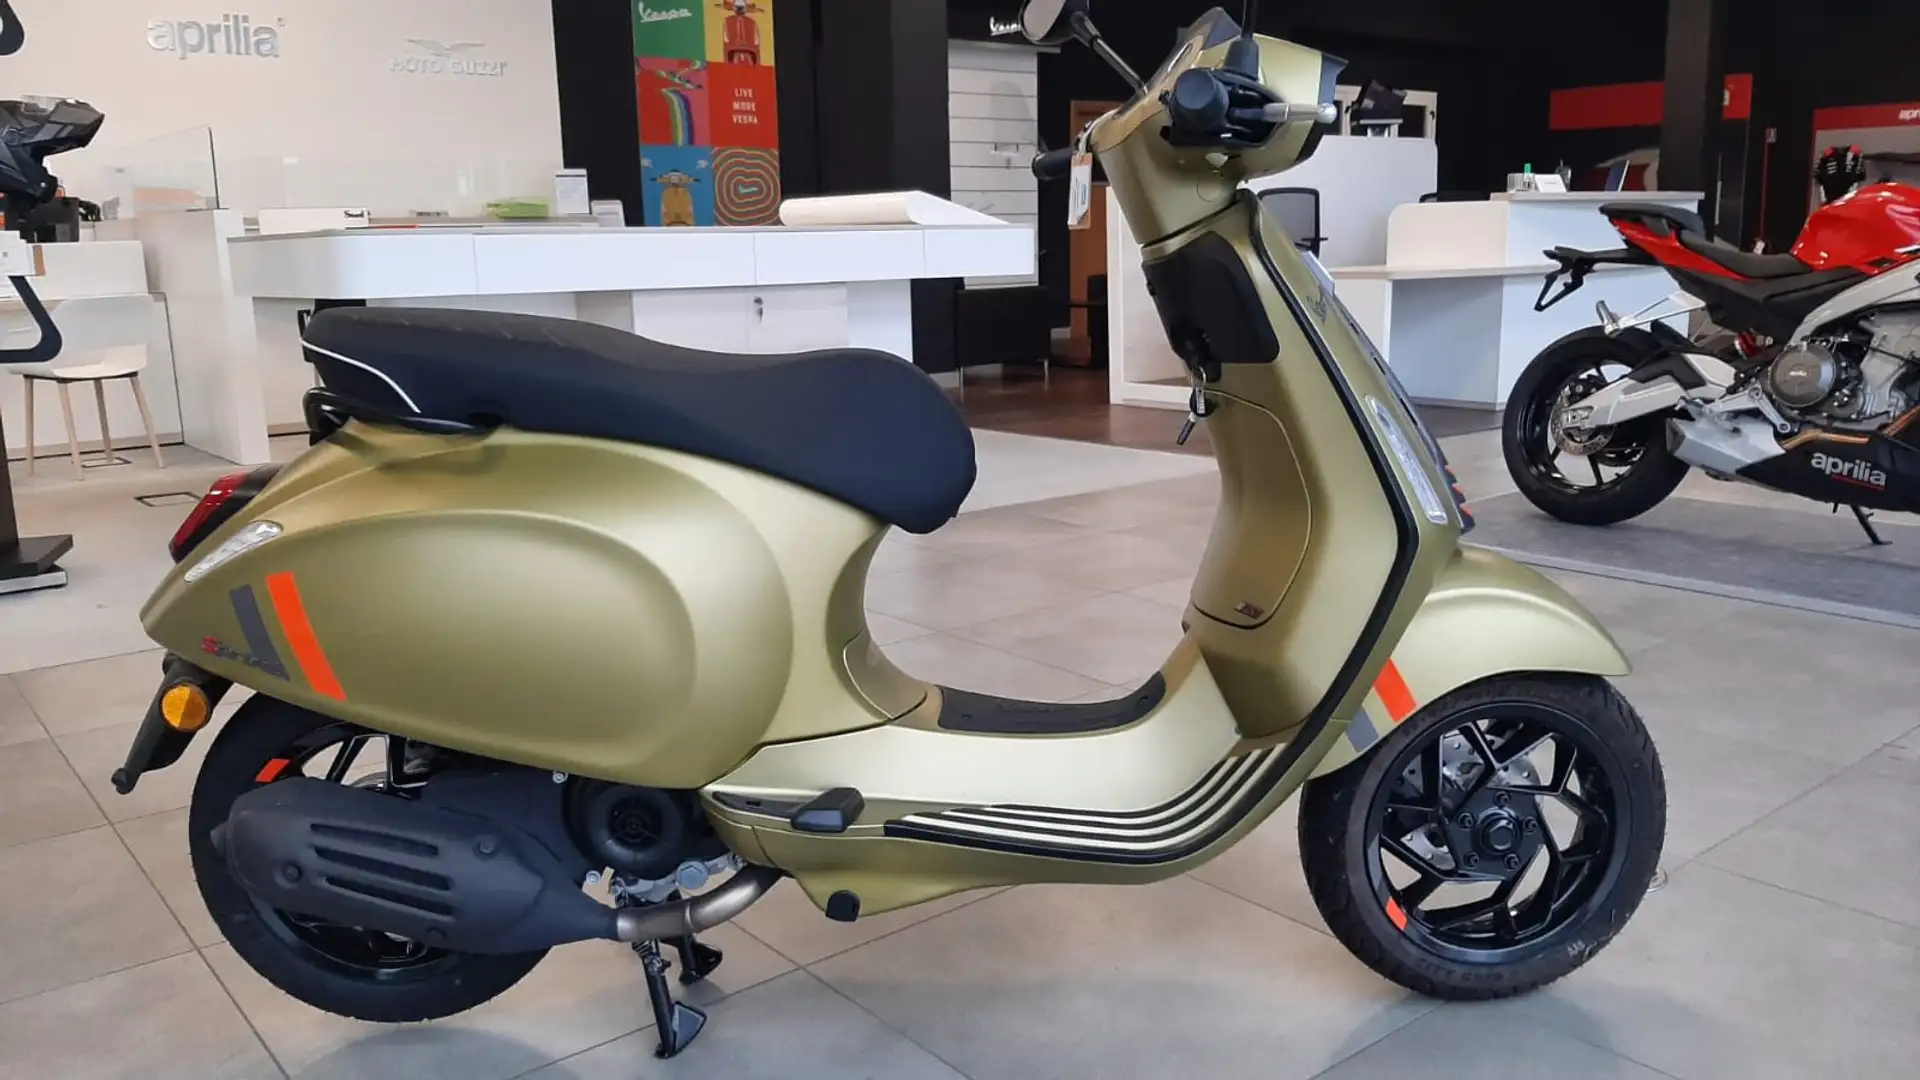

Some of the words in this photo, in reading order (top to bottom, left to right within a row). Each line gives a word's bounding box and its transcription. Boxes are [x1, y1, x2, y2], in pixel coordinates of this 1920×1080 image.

[638, 1, 693, 23] Vespa
[147, 12, 281, 60] aprilia
[389, 56, 442, 74] MOTO
[734, 87, 754, 98] LIVE
[732, 100, 756, 112] MORE
[732, 114, 759, 125] VESPA
[1811, 452, 1887, 486] aprilia
